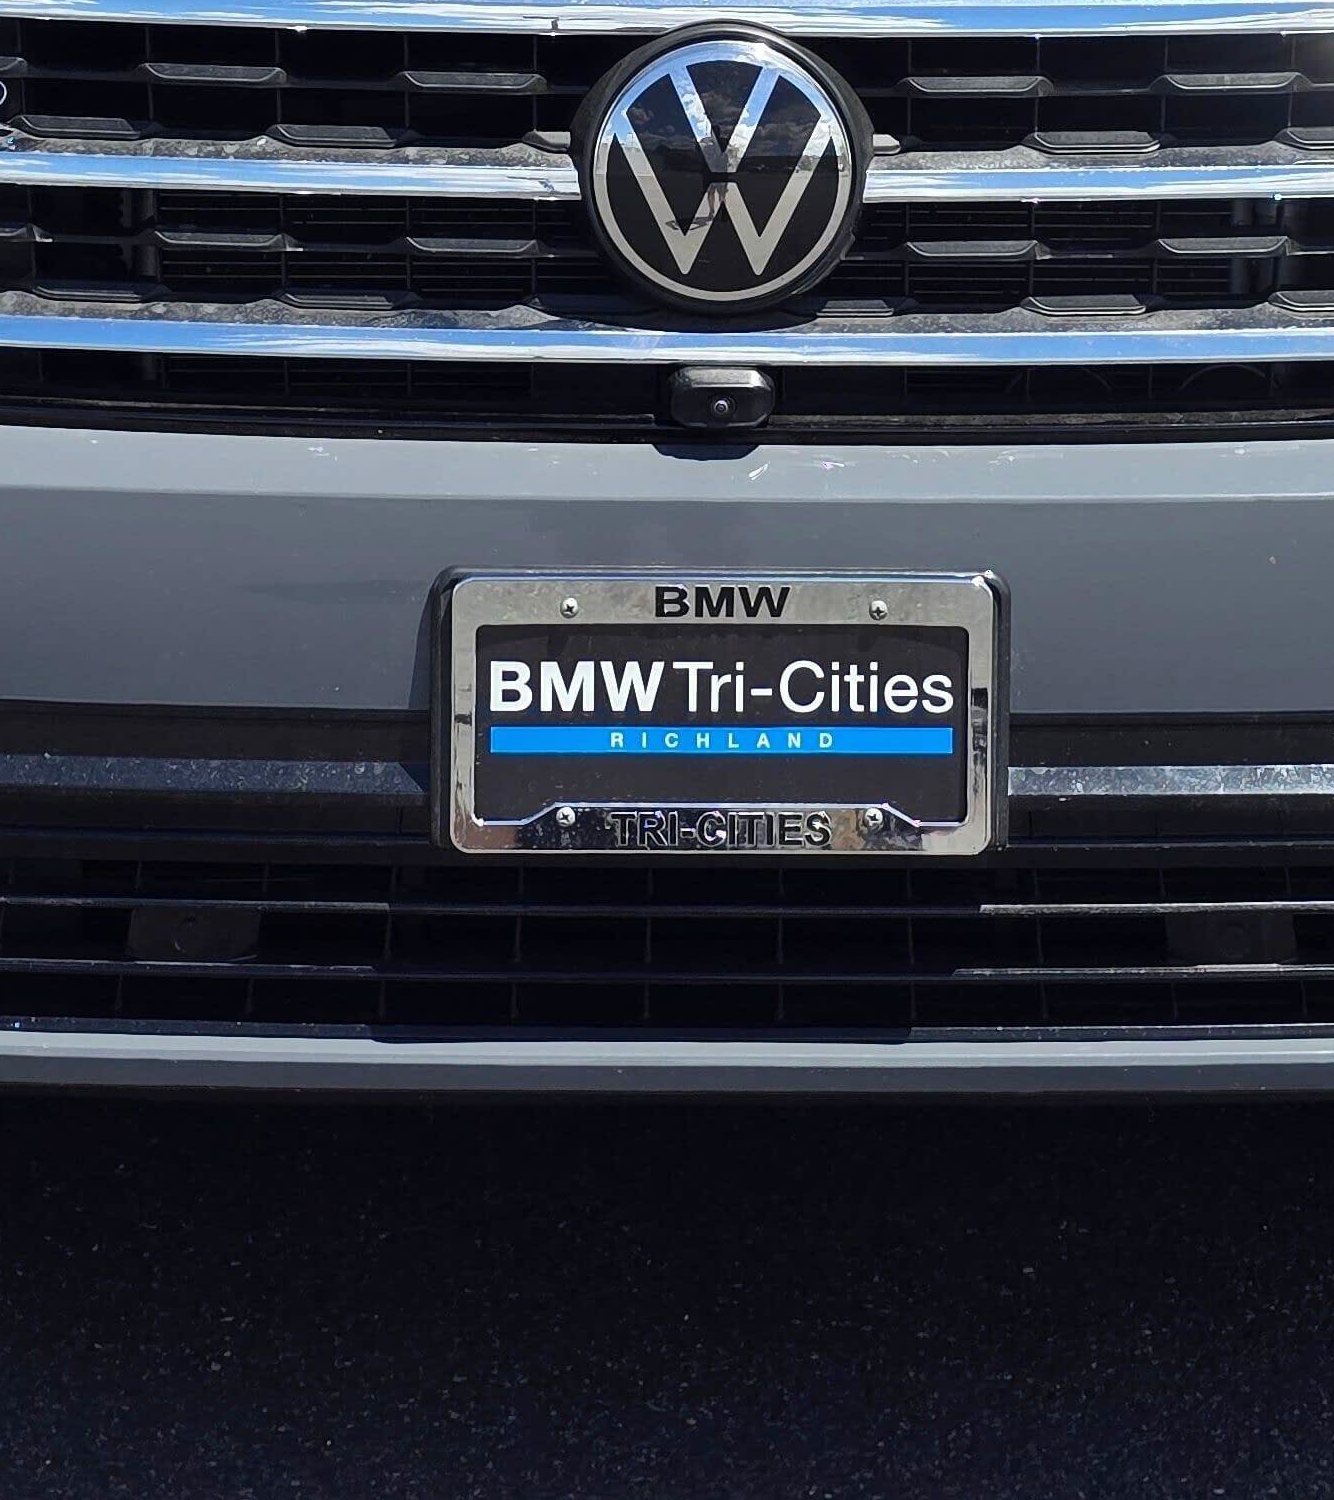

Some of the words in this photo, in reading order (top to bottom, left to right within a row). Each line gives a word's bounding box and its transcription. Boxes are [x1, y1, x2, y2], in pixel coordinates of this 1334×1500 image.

[604, 53, 842, 279] VW
[654, 586, 791, 618] BMW
[489, 660, 665, 713] BMW
[673, 660, 954, 714] Tri-Cities
[610, 731, 834, 750] RICHLAND
[611, 811, 833, 848] TRI-CITIES
